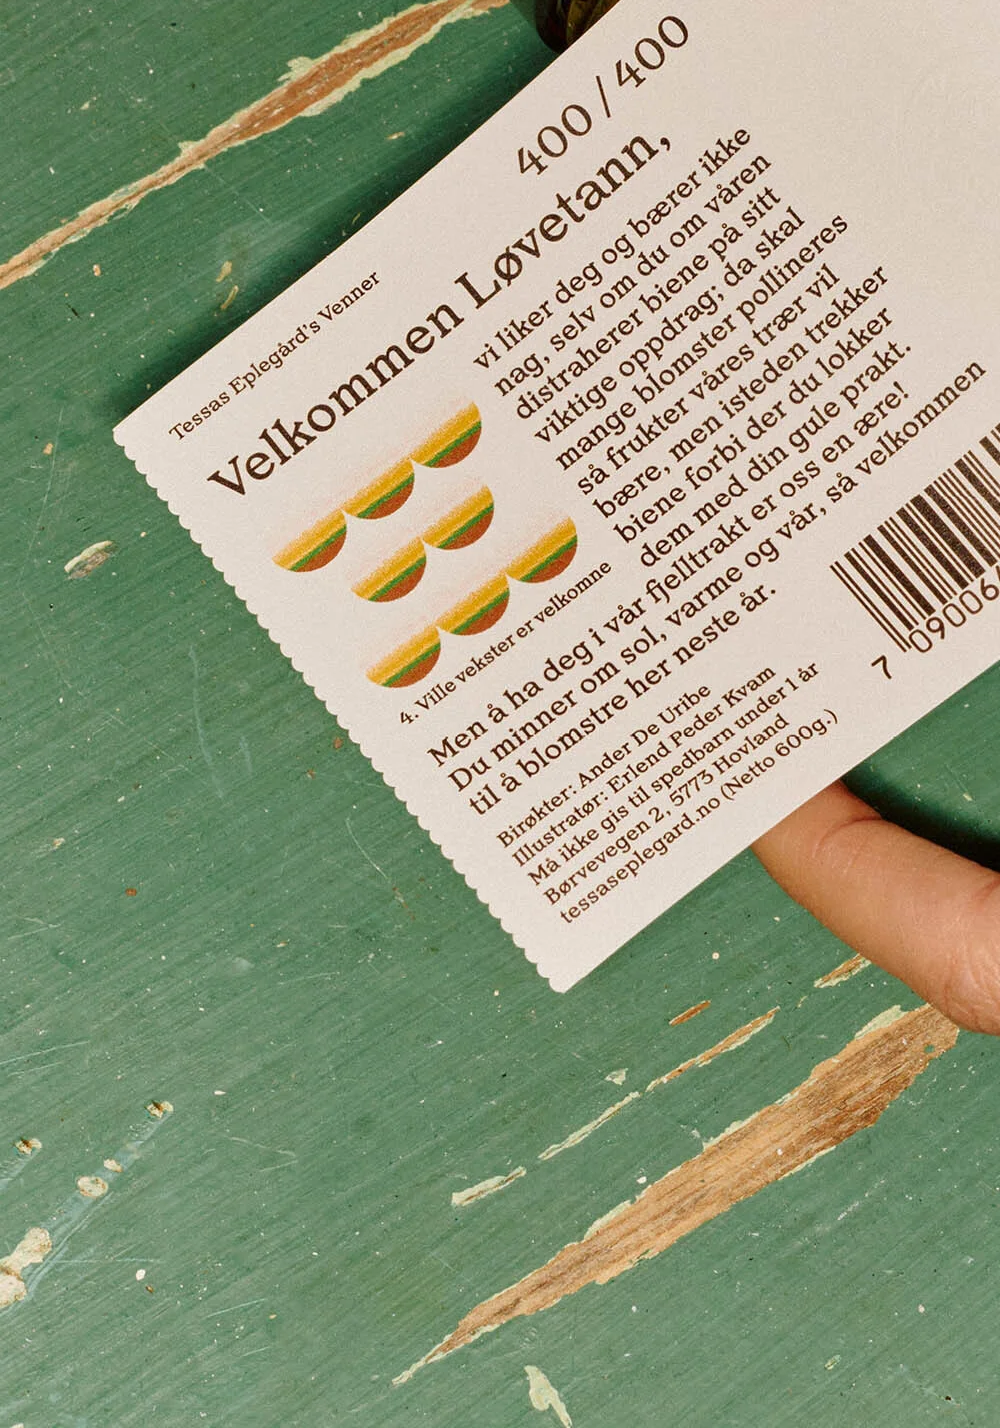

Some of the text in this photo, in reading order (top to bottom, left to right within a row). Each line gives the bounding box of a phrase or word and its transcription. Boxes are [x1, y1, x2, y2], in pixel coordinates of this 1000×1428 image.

[517, 103, 593, 176] 400
[614, 15, 689, 88] 400
[167, 271, 380, 440] Tessas Eplegård's Venner
[205, 135, 671, 496] Velkommen Løvetann,
[472, 128, 751, 369] vi liker deg og bærer ikke
[493, 155, 772, 397] nag, selv om du om våren
[516, 186, 782, 420] distraherer biene på sitt
[533, 204, 806, 443] viktige oppdrag; da skal
[554, 214, 848, 471] mange blomster pollineres
[576, 261, 841, 496] så frukter våres trær vil
[591, 265, 888, 519] bære, men isteden trekker
[612, 306, 893, 544] biene forbi der du lokker
[639, 340, 912, 568] dem med din gule prakt.
[399, 561, 612, 725] 4. Ville vekster er velkomne
[426, 380, 909, 768] Men å ha deg i vår fjelltrakt er oss en ære!
[446, 361, 987, 793] Du minner om sol, varme og vår, så velkommen
[870, 655, 892, 679] 7
[468, 584, 776, 816] til å blomstre her neste år.
[495, 685, 711, 849] Birøkter: Ander De Uribe
[511, 667, 777, 868] Illustratør: Erlend Peder Kvam
[526, 662, 819, 887] Må ikke gis til spedbarn under 1 år
[542, 712, 790, 906] Børvevegen 2, 5773 Hovland
[559, 708, 838, 924] tessaseplegard.no (Netto 600g.)
